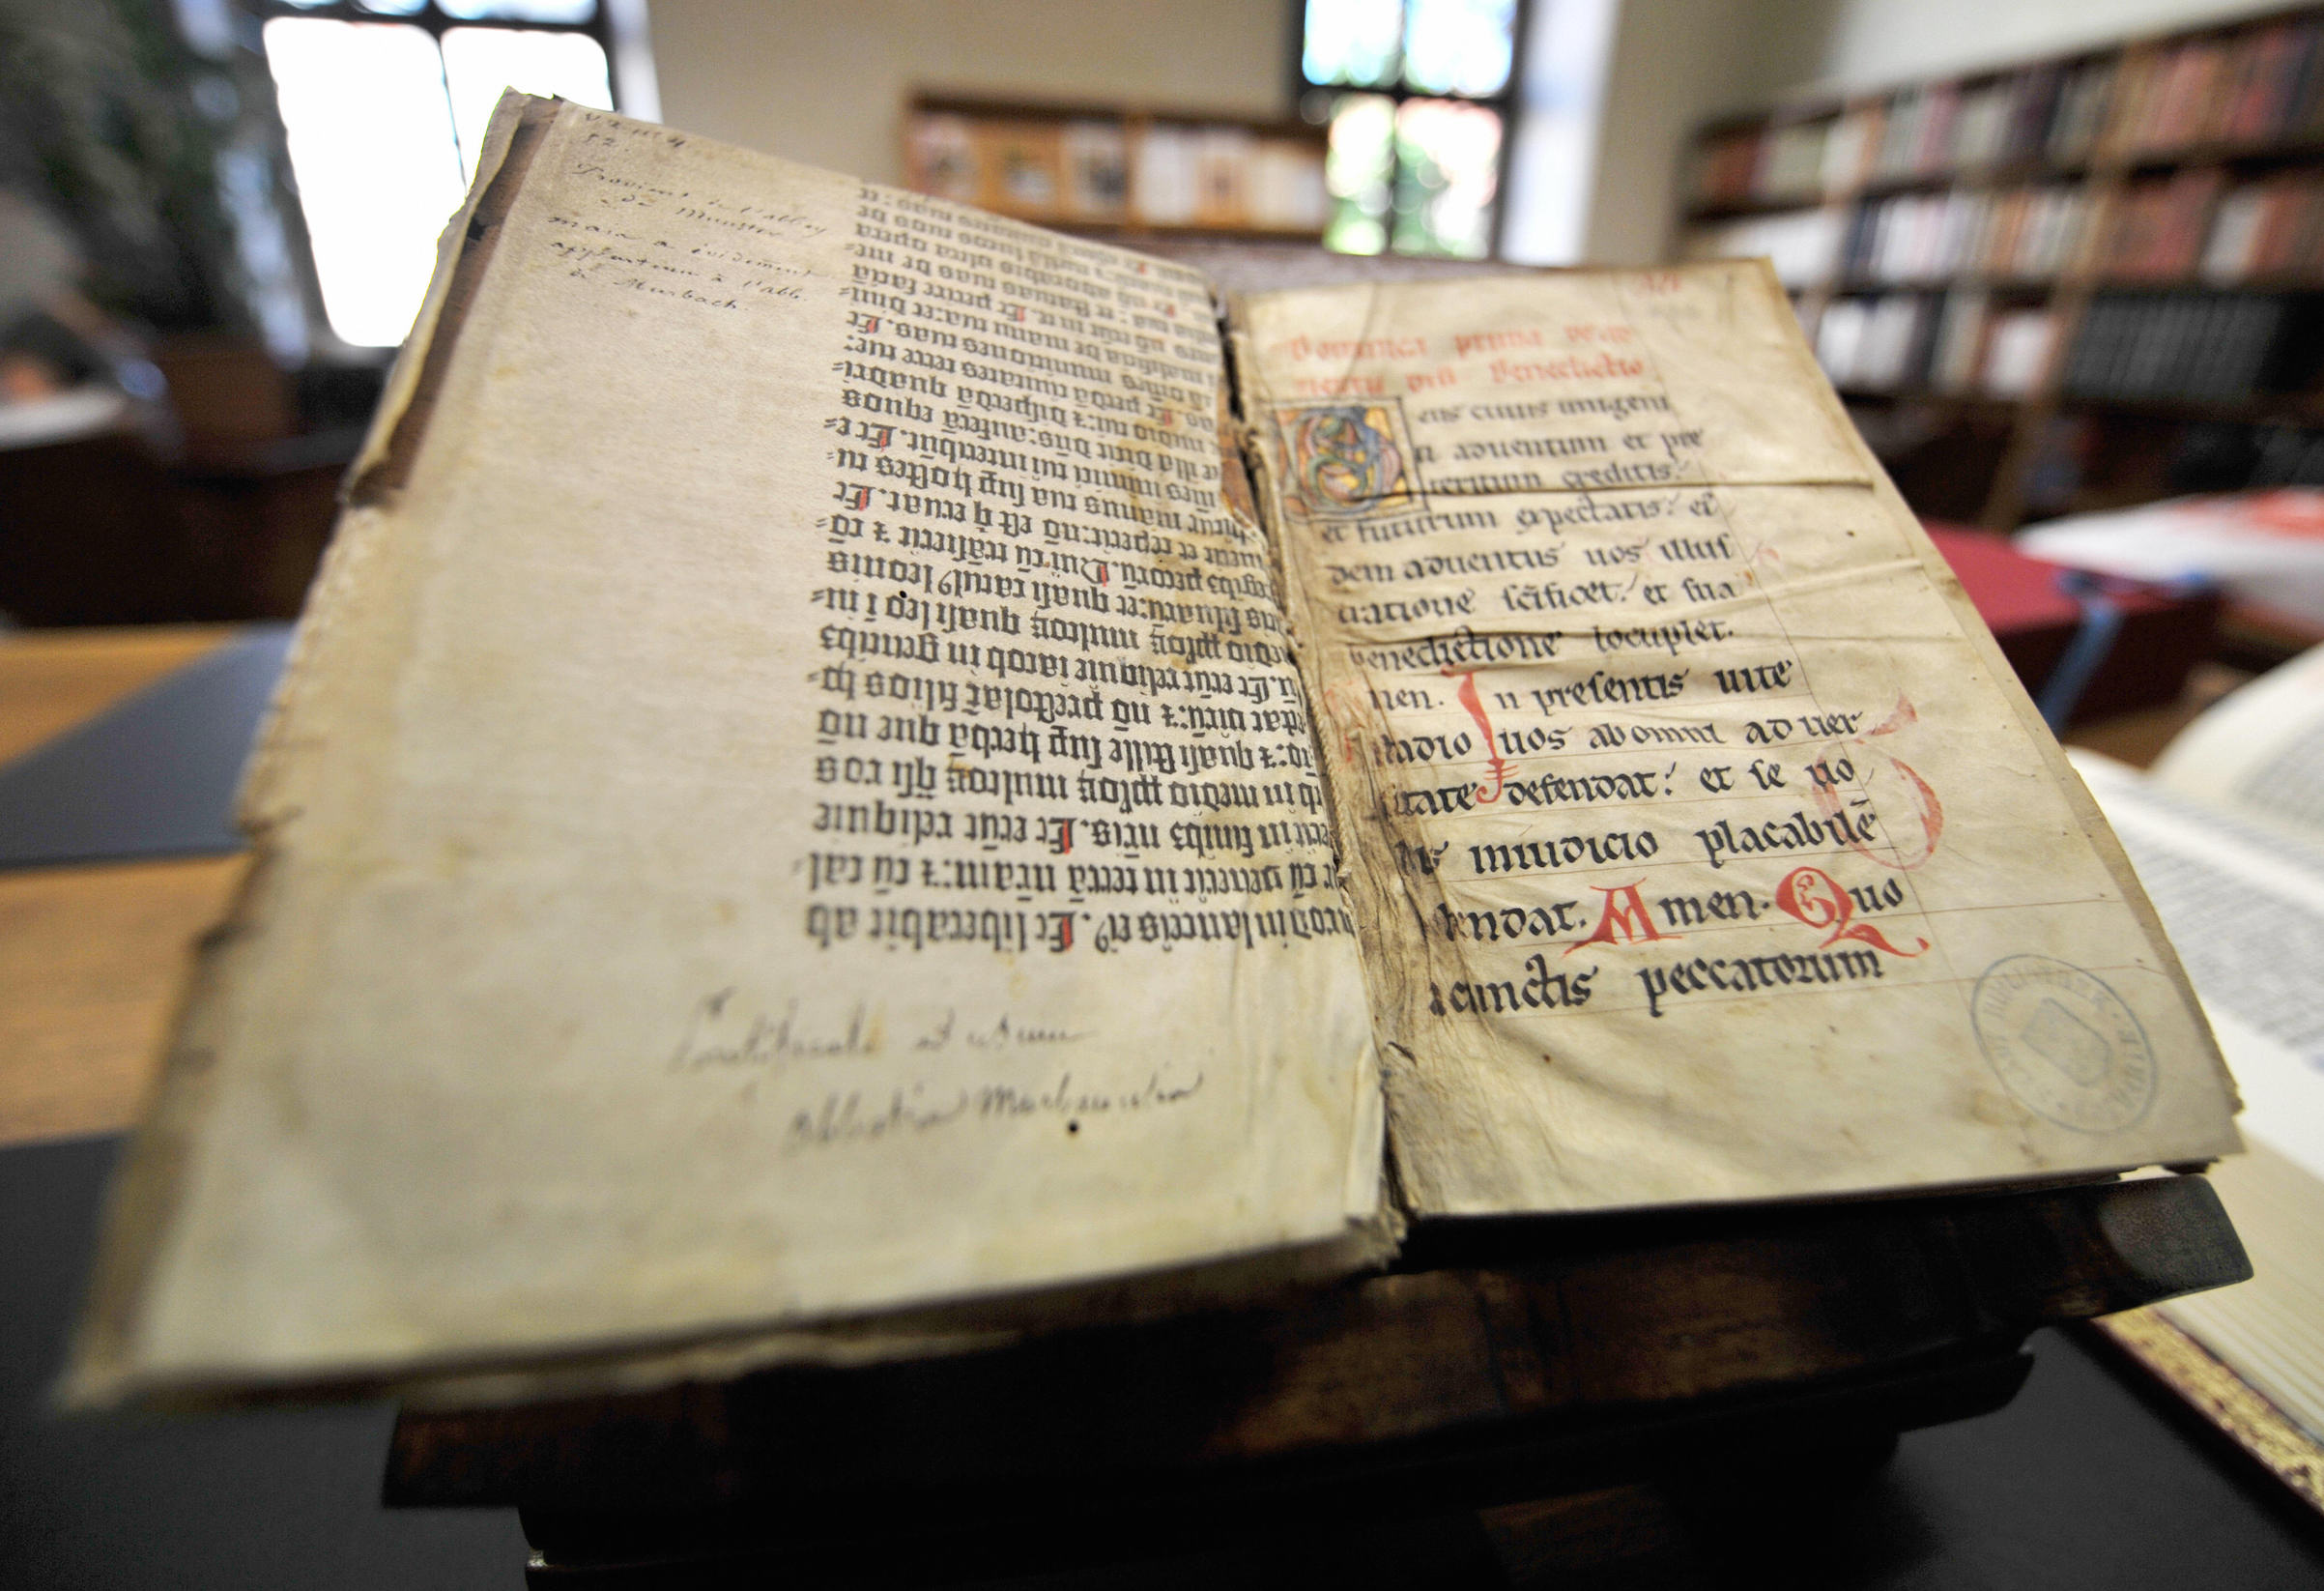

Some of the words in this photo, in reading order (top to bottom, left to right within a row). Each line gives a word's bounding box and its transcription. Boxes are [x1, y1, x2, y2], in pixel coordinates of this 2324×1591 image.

[841, 389, 933, 425] equos
[854, 420, 897, 452] Et
[831, 480, 875, 512] Et
[1083, 495, 1181, 530] manus
[825, 550, 934, 594] leonis
[884, 594, 932, 631] leo
[946, 642, 982, 677] in
[986, 646, 1069, 687] iacob
[1074, 656, 1181, 697] reliquie
[865, 672, 959, 713] filios
[1237, 676, 1270, 706] Et
[875, 713, 940, 748] que
[814, 756, 882, 786] ros
[1700, 766, 1735, 794] et
[1168, 781, 1259, 818] medio
[813, 798, 954, 849] reliquie
[1035, 816, 1077, 856] Et
[1143, 866, 1179, 905] in
[804, 905, 858, 951] ab
[868, 908, 1028, 953] liberabit
[1035, 911, 1076, 953] Et
[1253, 910, 1287, 949] in
